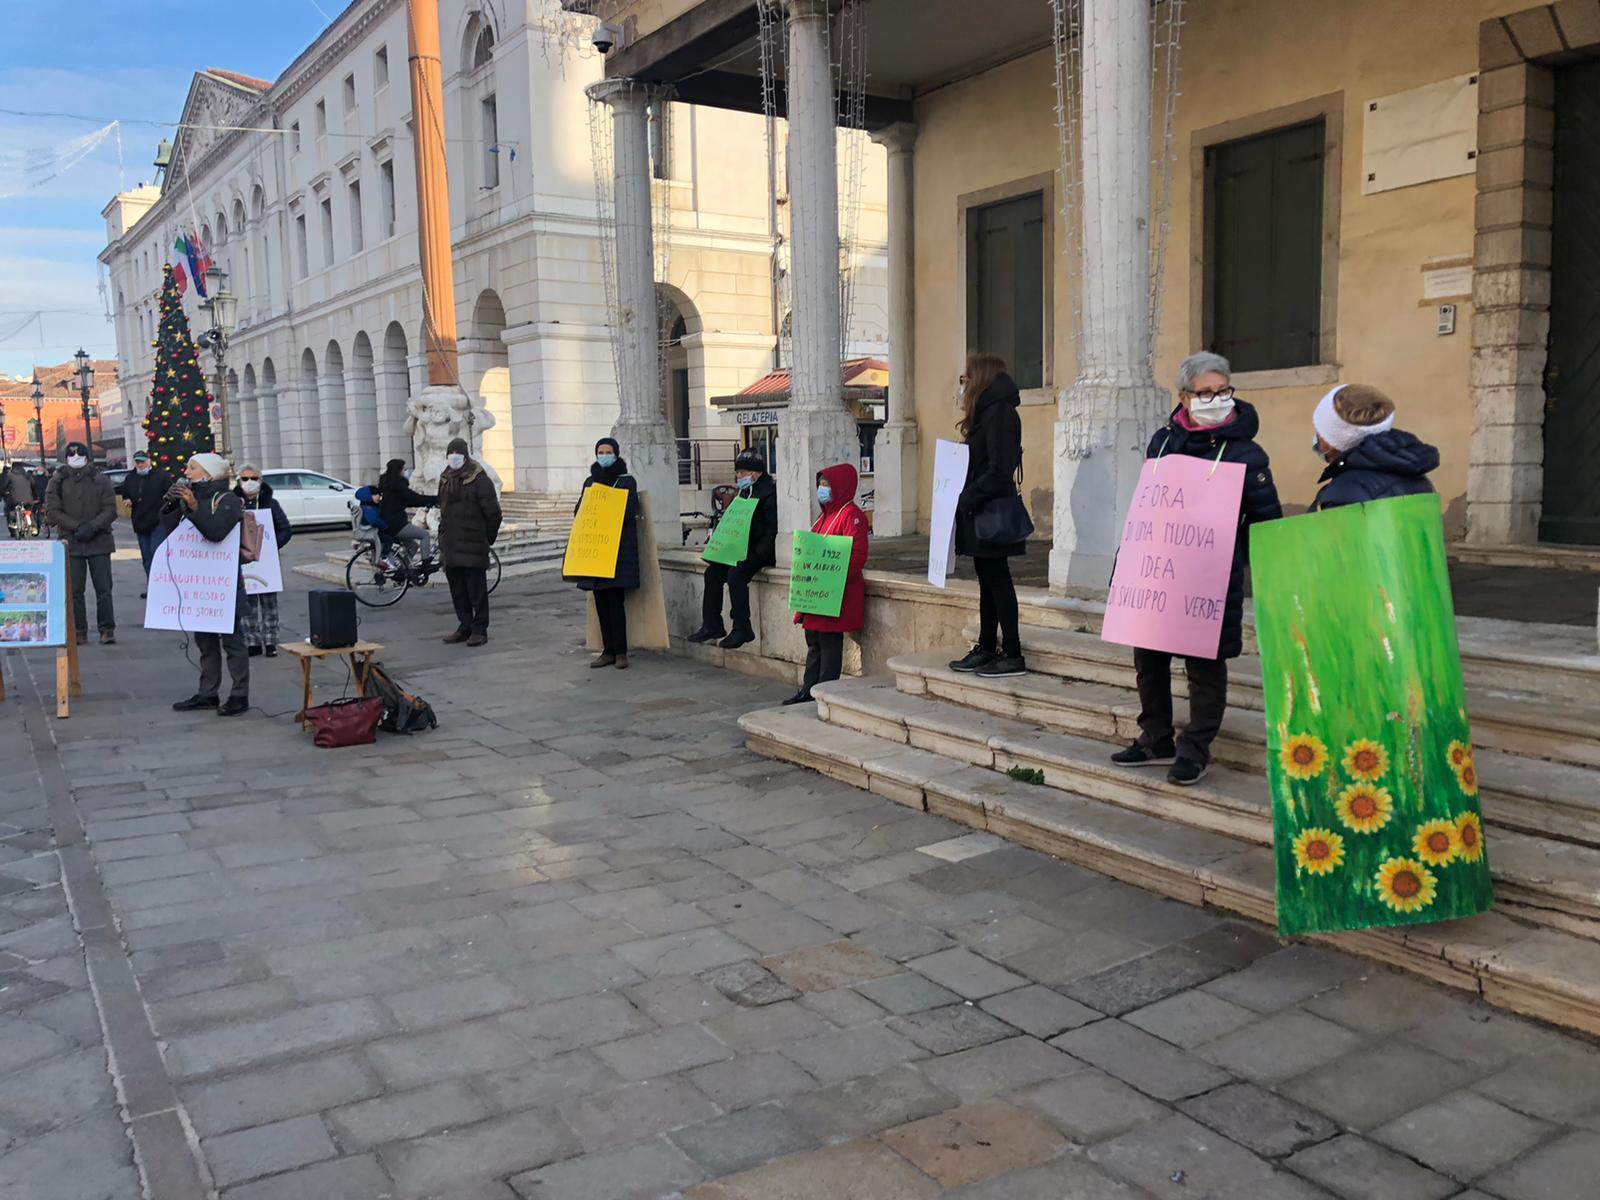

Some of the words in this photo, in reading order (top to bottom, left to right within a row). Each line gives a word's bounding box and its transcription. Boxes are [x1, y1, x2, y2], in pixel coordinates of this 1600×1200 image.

[737, 411, 778, 424] GELATERIA
[1150, 484, 1185, 509] ORA
[1164, 522, 1215, 550] NUOVA
[1140, 555, 1175, 580] IDEA
[1117, 585, 1167, 612] SVILUPPO
[1184, 594, 1223, 621] VERDE
